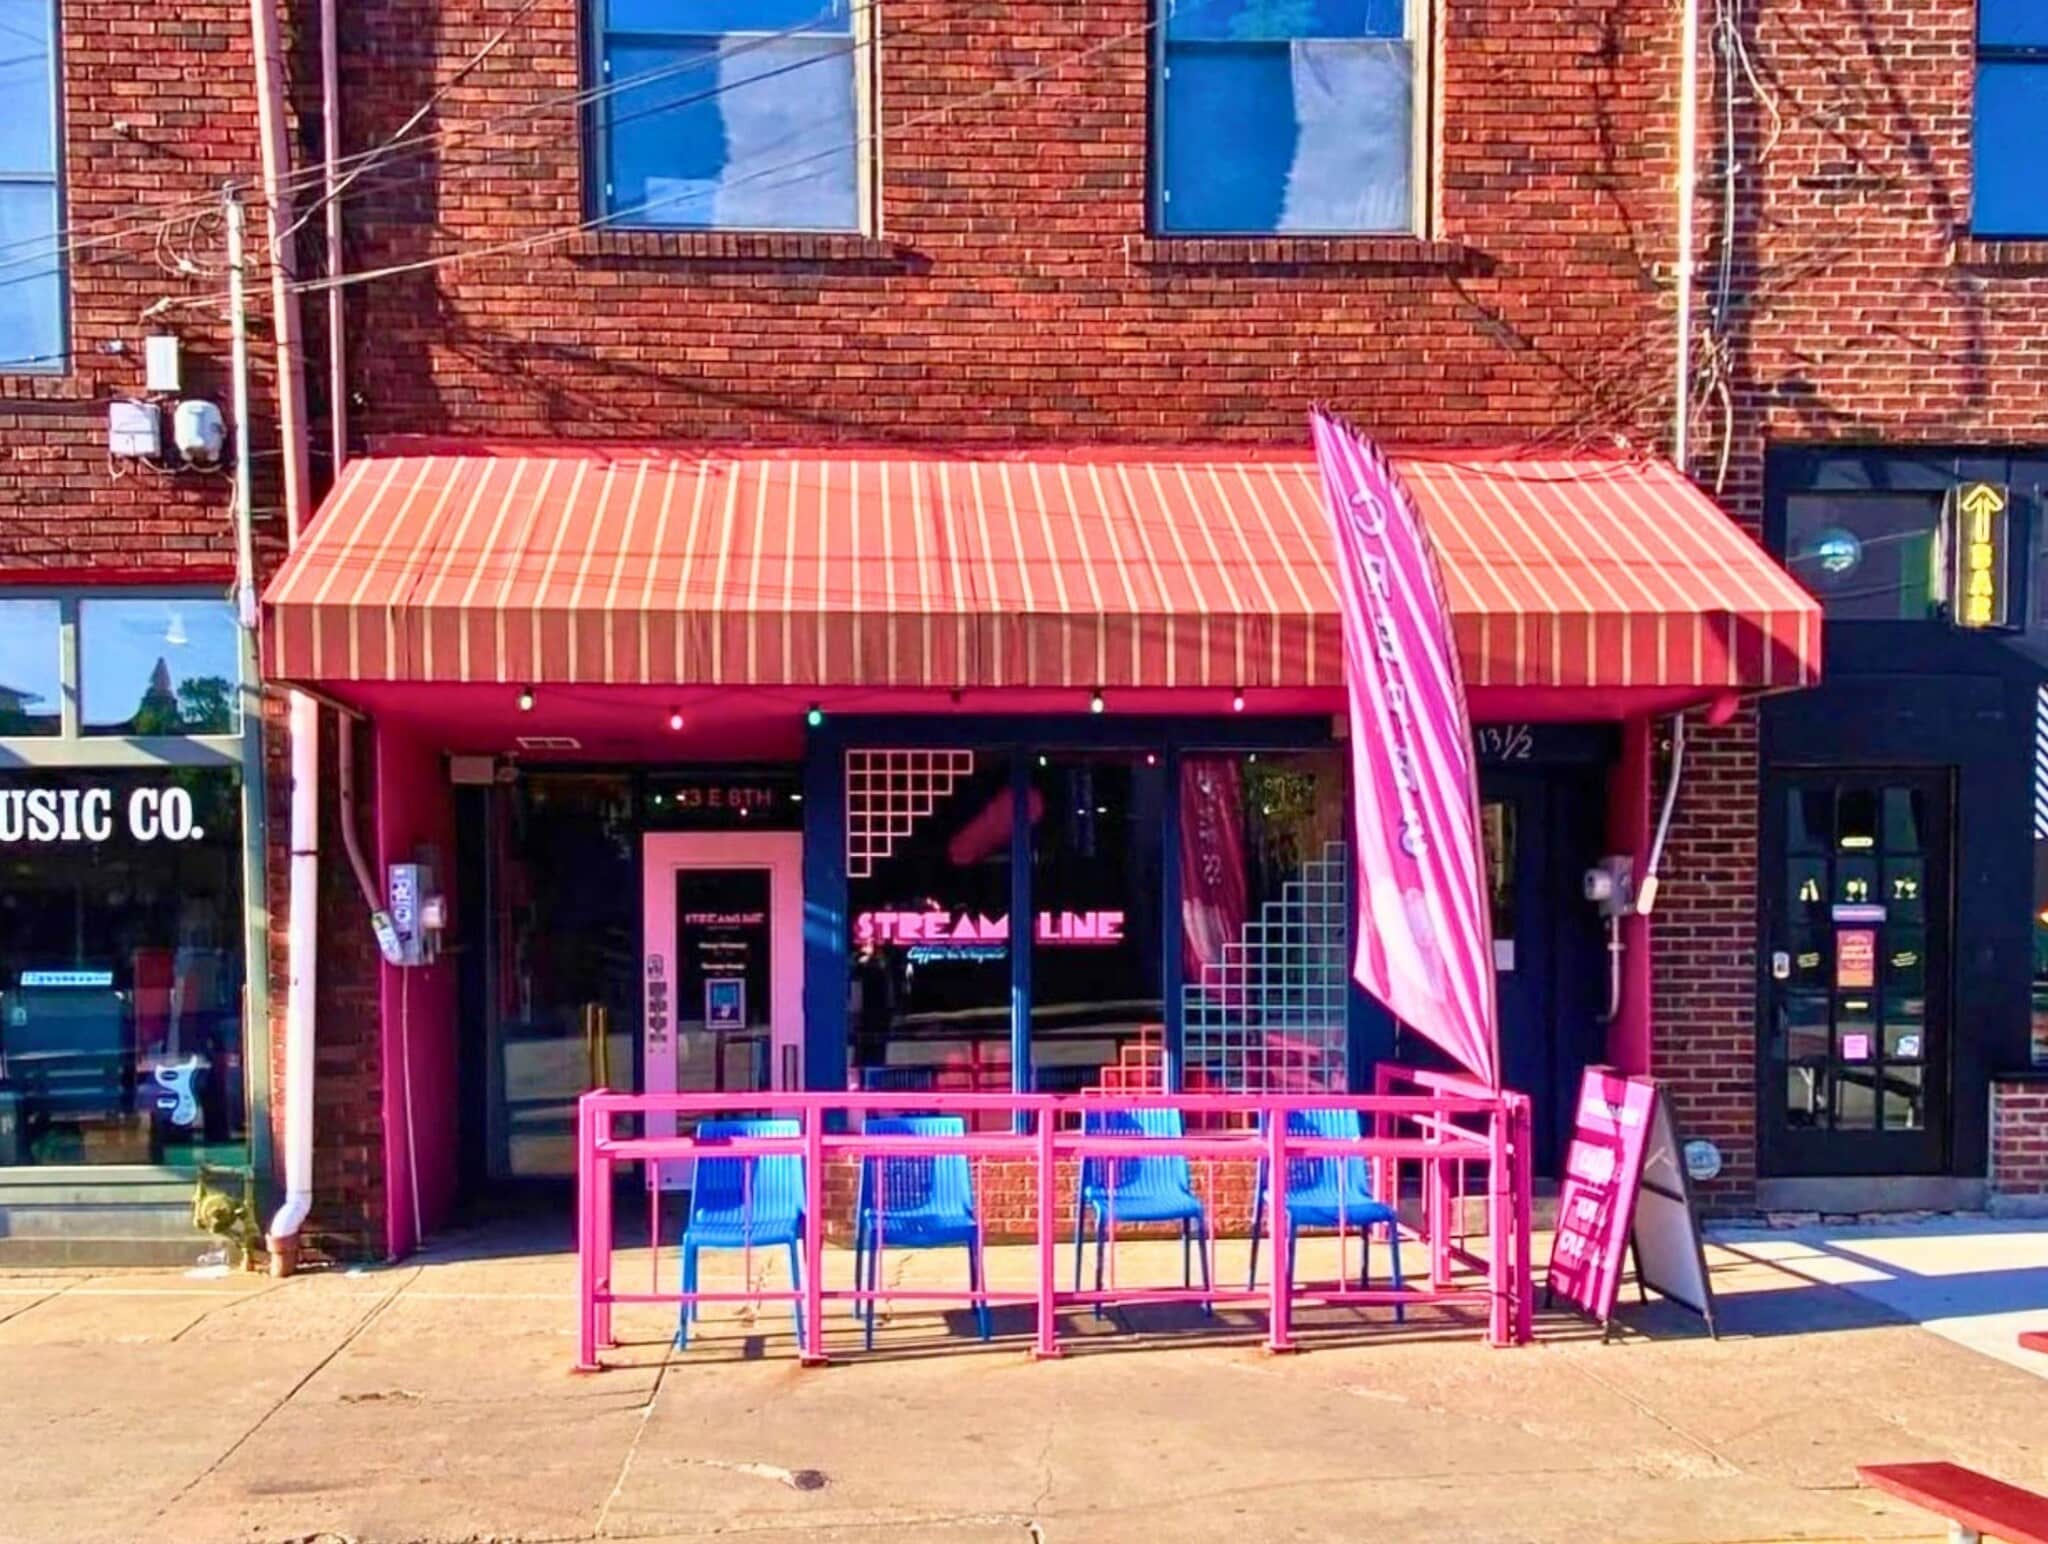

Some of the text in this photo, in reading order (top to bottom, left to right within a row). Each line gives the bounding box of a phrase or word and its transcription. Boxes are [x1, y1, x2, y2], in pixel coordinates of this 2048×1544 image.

[708, 788, 722, 807] E
[729, 787, 772, 807] 8TH
[129, 787, 204, 841] CO.
[857, 911, 1125, 943] STREAM LINE
